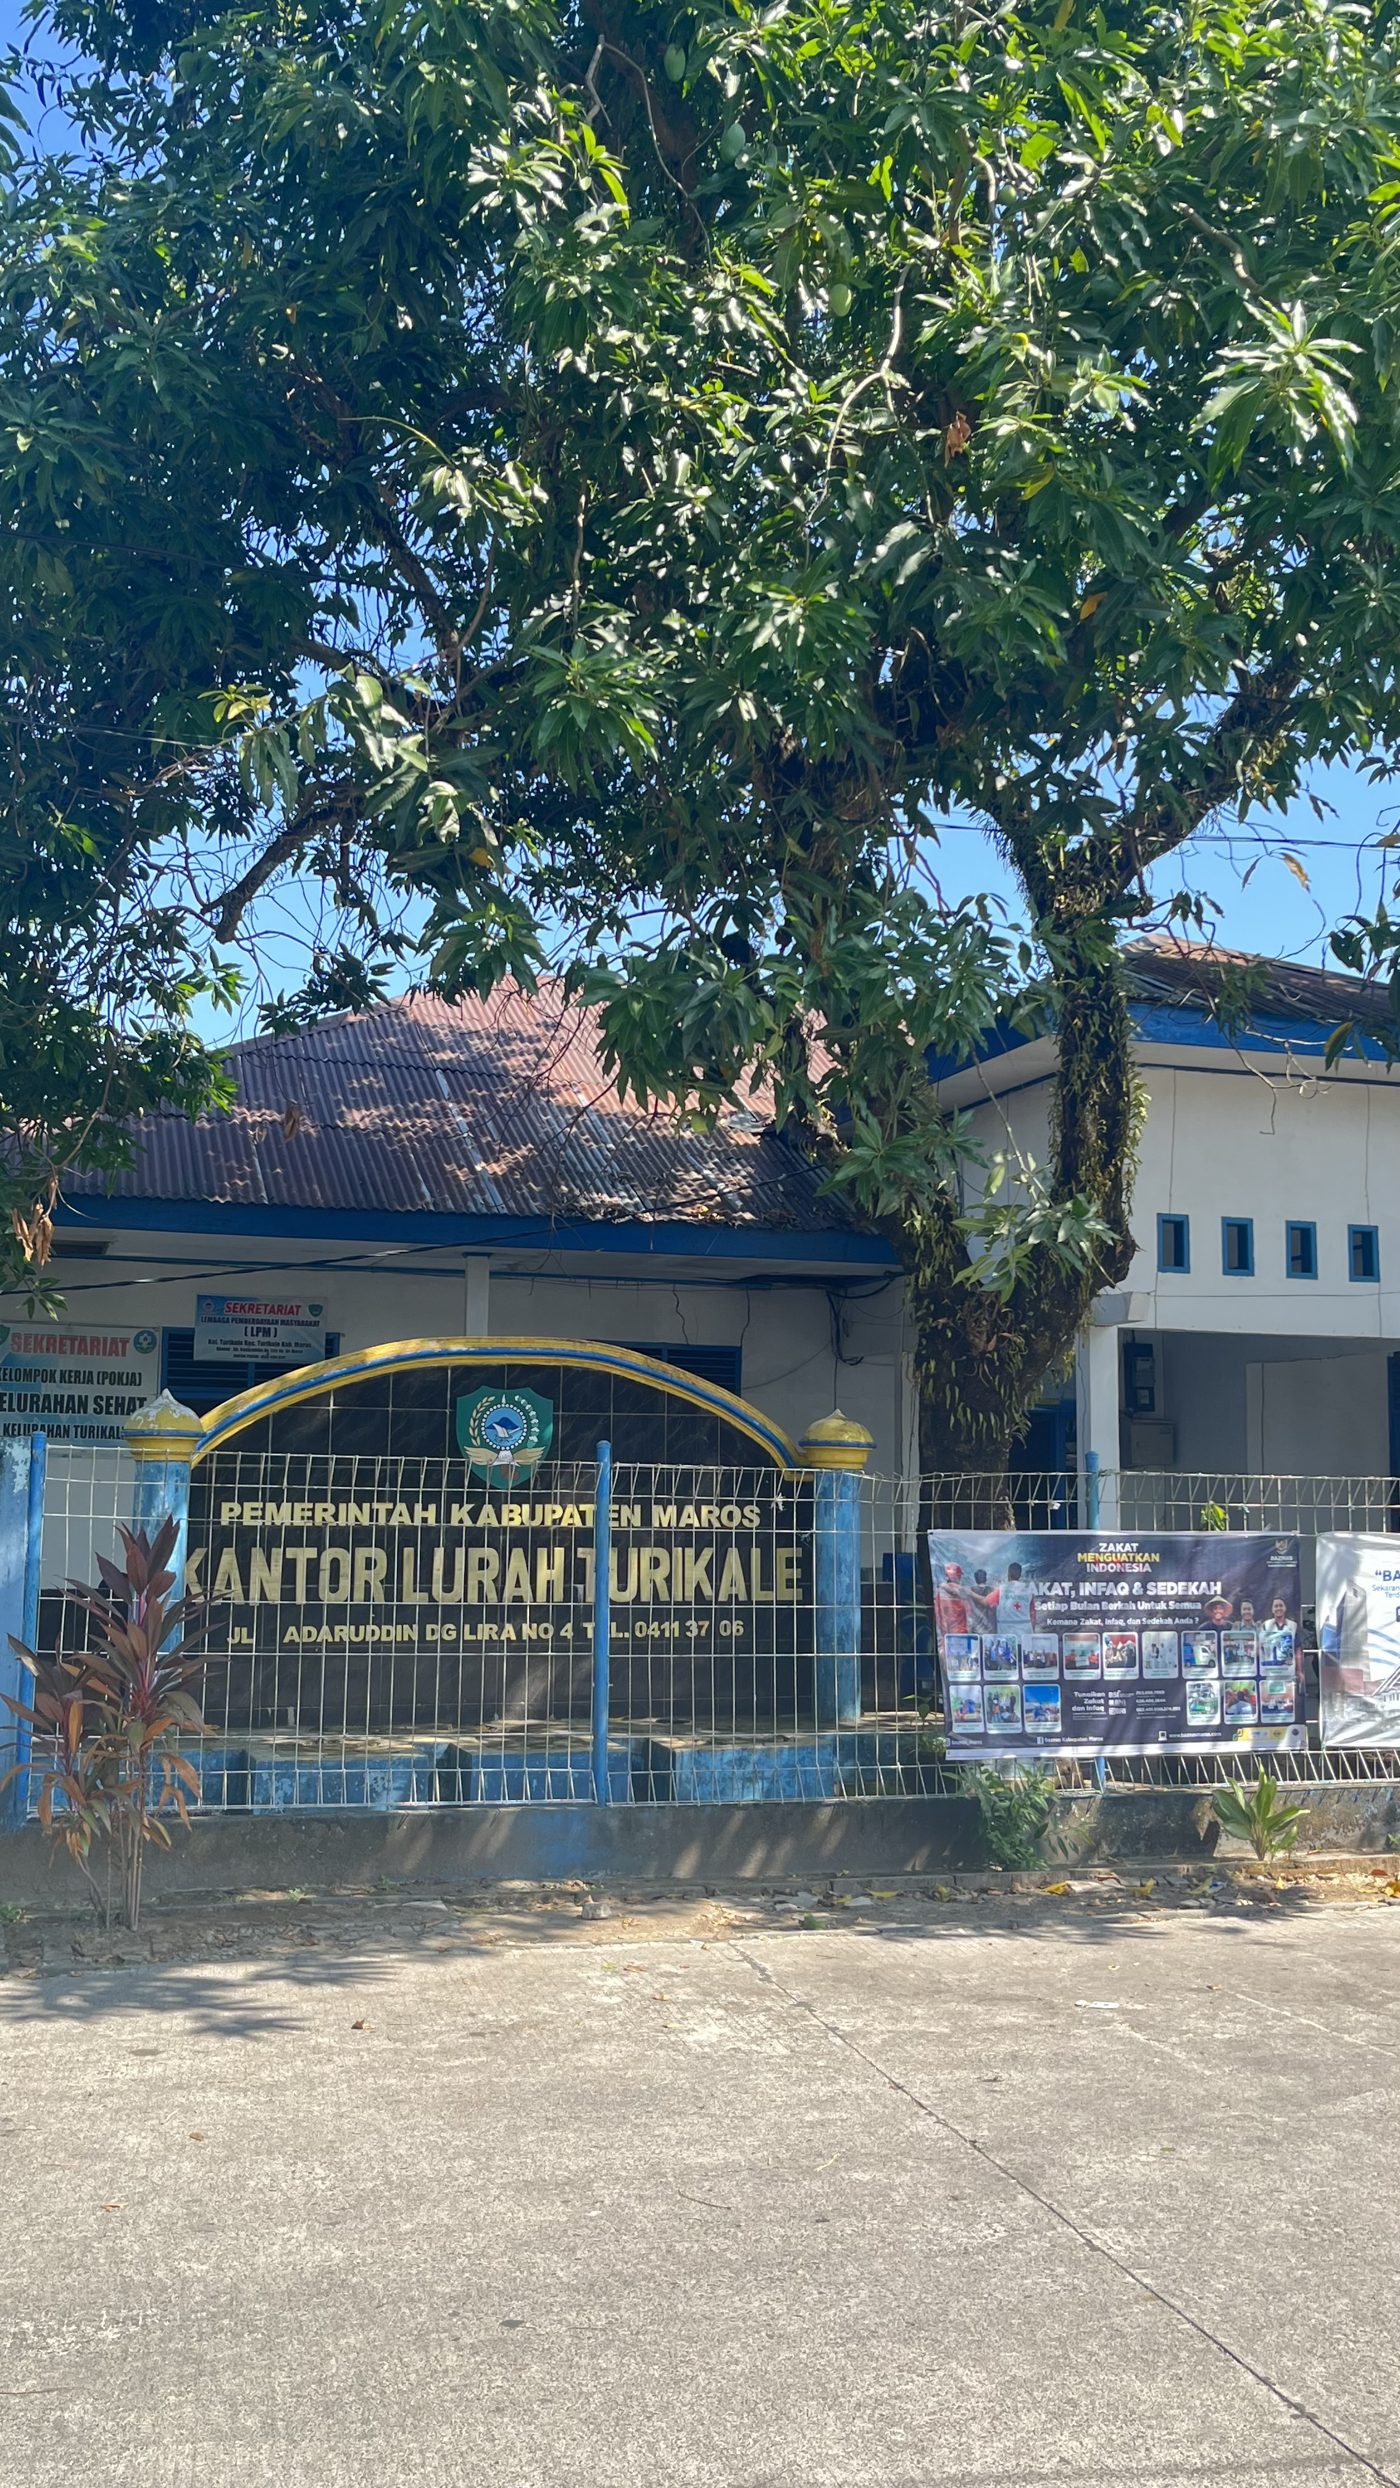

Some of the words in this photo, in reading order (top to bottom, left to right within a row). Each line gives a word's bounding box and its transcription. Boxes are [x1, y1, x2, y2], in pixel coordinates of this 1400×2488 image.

[224, 1302, 301, 1316] SEKRETARIAT
[11, 1332, 130, 1357] SEKRETARIAT
[59, 1369, 94, 1385] KERJA
[97, 1370, 142, 1387] (POKJA)
[0, 1392, 89, 1414] ELURAHAN
[92, 1395, 147, 1416] SEHAT
[73, 1425, 123, 1440] TURIKAL
[221, 1502, 436, 1526] PEMERINTAH
[451, 1503, 641, 1527] KABUPATEN
[652, 1504, 761, 1527] MAROS
[1099, 1543, 1139, 1552] ZAKAT
[1077, 1553, 1160, 1563] MENGUATKAN
[1086, 1563, 1152, 1573] INDONESIA
[185, 1547, 388, 1605] KANTOR
[403, 1547, 565, 1604] LURAH
[577, 1548, 803, 1602] TURIKALE
[1079, 1582, 1130, 1596] INFAQ
[1132, 1582, 1143, 1596] &
[1146, 1582, 1222, 1596] SEDEKAH
[1034, 1600, 1069, 1612] Setiap
[1070, 1600, 1100, 1611] Bulan
[1101, 1600, 1136, 1611] Berkah
[1137, 1600, 1167, 1610] Untuk
[1168, 1600, 1202, 1610] Semua
[1046, 1618, 1078, 1626] Kemana
[1080, 1617, 1104, 1627] Zakat,
[1105, 1617, 1125, 1627] Infaq,
[1126, 1617, 1141, 1625] dan
[1142, 1616, 1173, 1625] Sedekah
[1174, 1616, 1193, 1625] Anda
[283, 1624, 418, 1644] ADARUDDIN
[425, 1624, 457, 1641] DG
[464, 1623, 516, 1642] LIRA
[522, 1623, 554, 1640] NO
[560, 1621, 573, 1639] 4
[583, 1621, 630, 1639] TL.
[634, 1621, 679, 1639] 0411
[685, 1621, 710, 1638] 37
[719, 1620, 744, 1637] 06
[1086, 1704, 1105, 1713] Infaq
